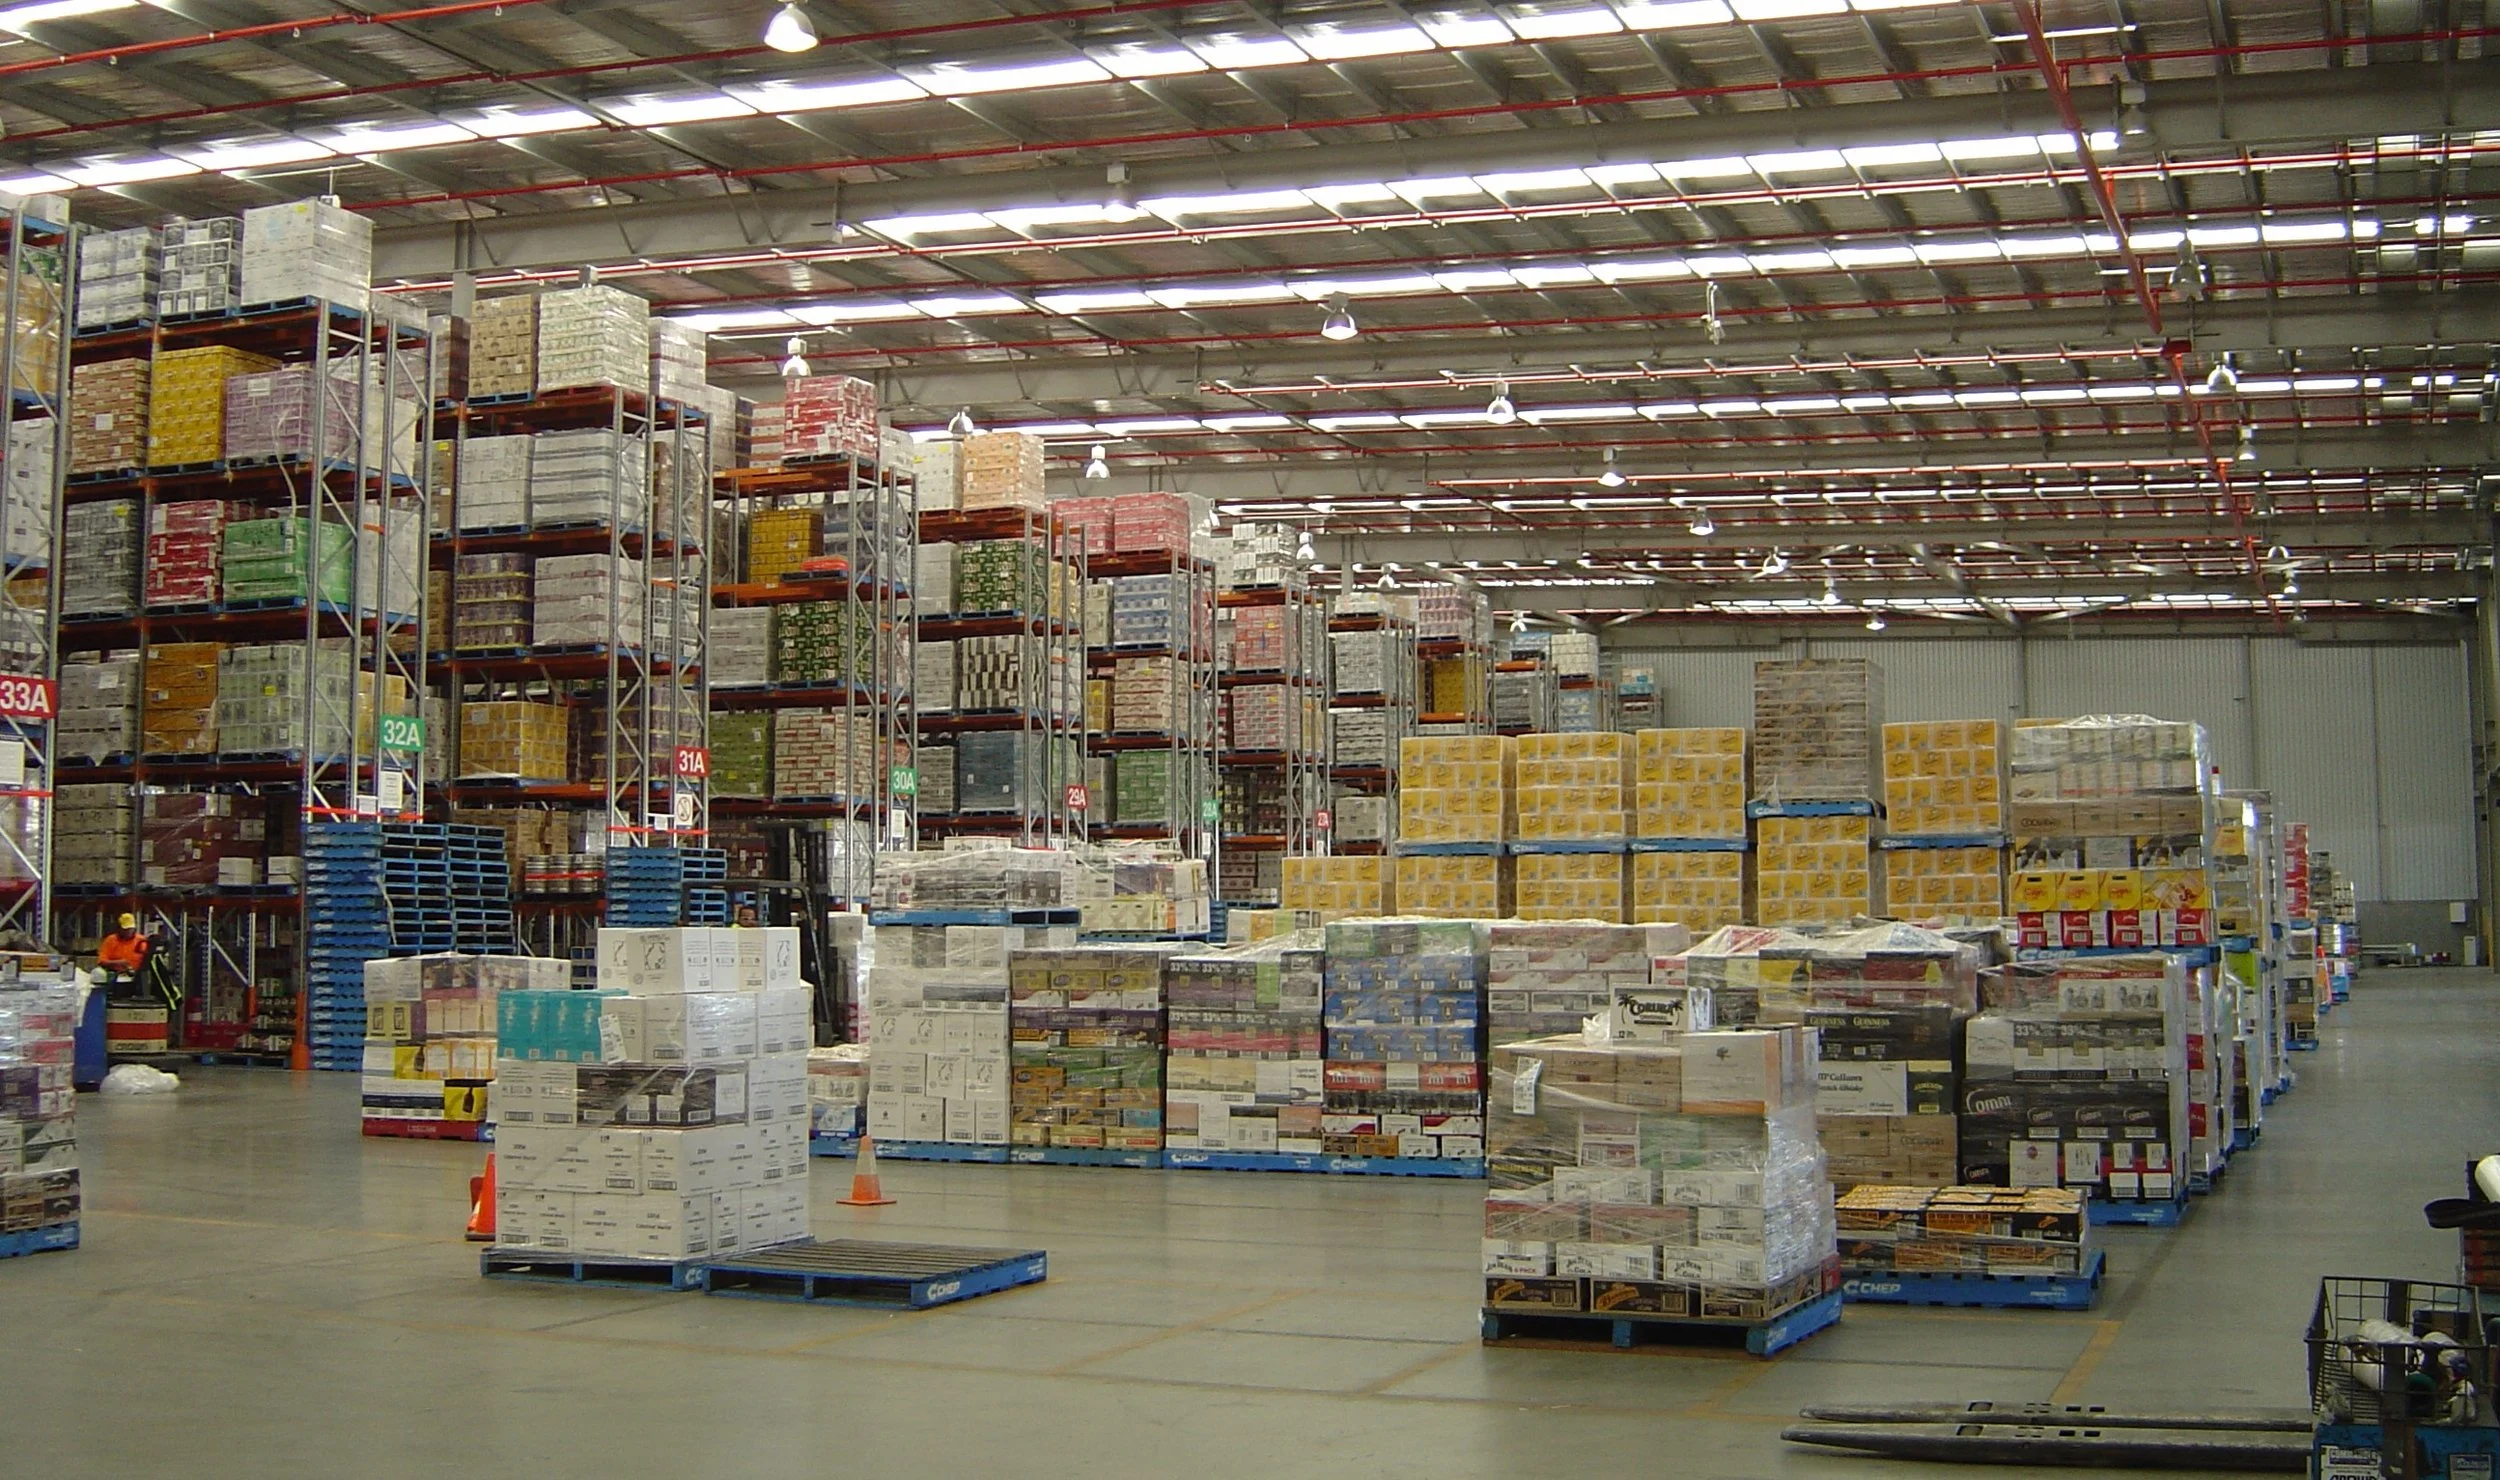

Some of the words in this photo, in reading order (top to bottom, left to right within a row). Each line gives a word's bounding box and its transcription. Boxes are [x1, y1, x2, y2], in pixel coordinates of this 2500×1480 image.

[0, 681, 50, 713] 33A
[384, 720, 420, 747] 32A
[679, 750, 705, 773] 31A
[893, 770, 915, 790] 30A
[1853, 1017, 1890, 1026] GUINNESS
[1860, 1282, 1902, 1294] CHEP
